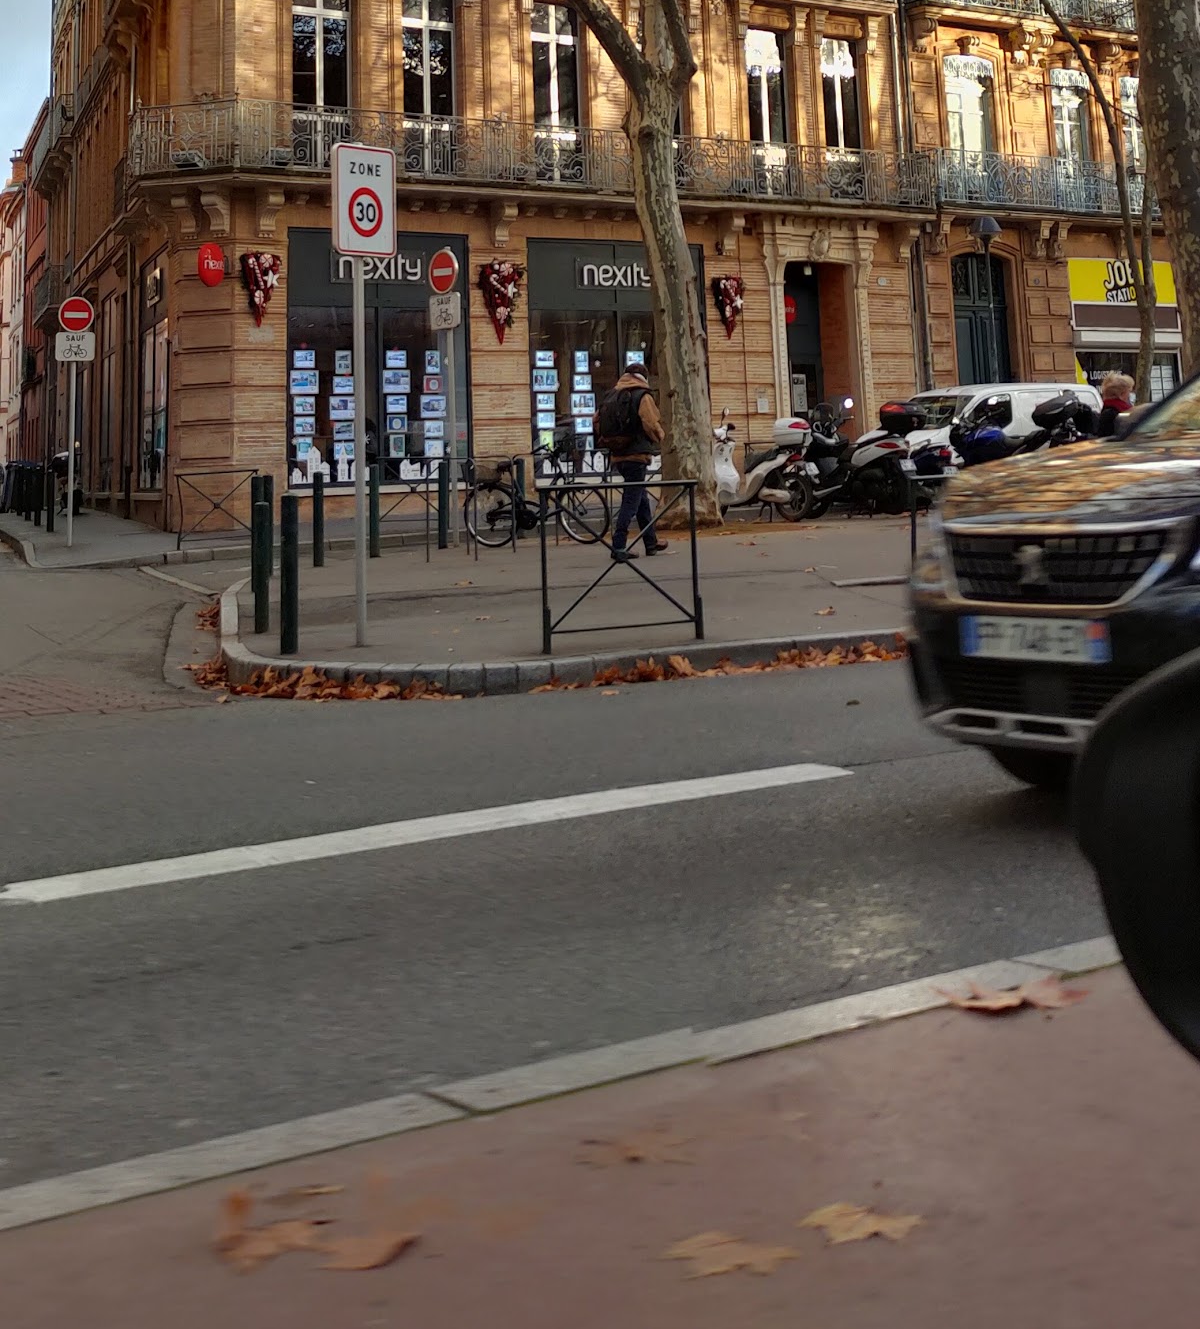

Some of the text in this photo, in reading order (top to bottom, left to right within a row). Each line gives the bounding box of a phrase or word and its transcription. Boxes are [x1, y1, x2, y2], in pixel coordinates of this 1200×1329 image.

[350, 162, 381, 177] ZONE
[356, 202, 376, 223] 30
[437, 296, 451, 306] SAUF
[1107, 286, 1137, 303] STATIO
[65, 334, 86, 342] SAUF
